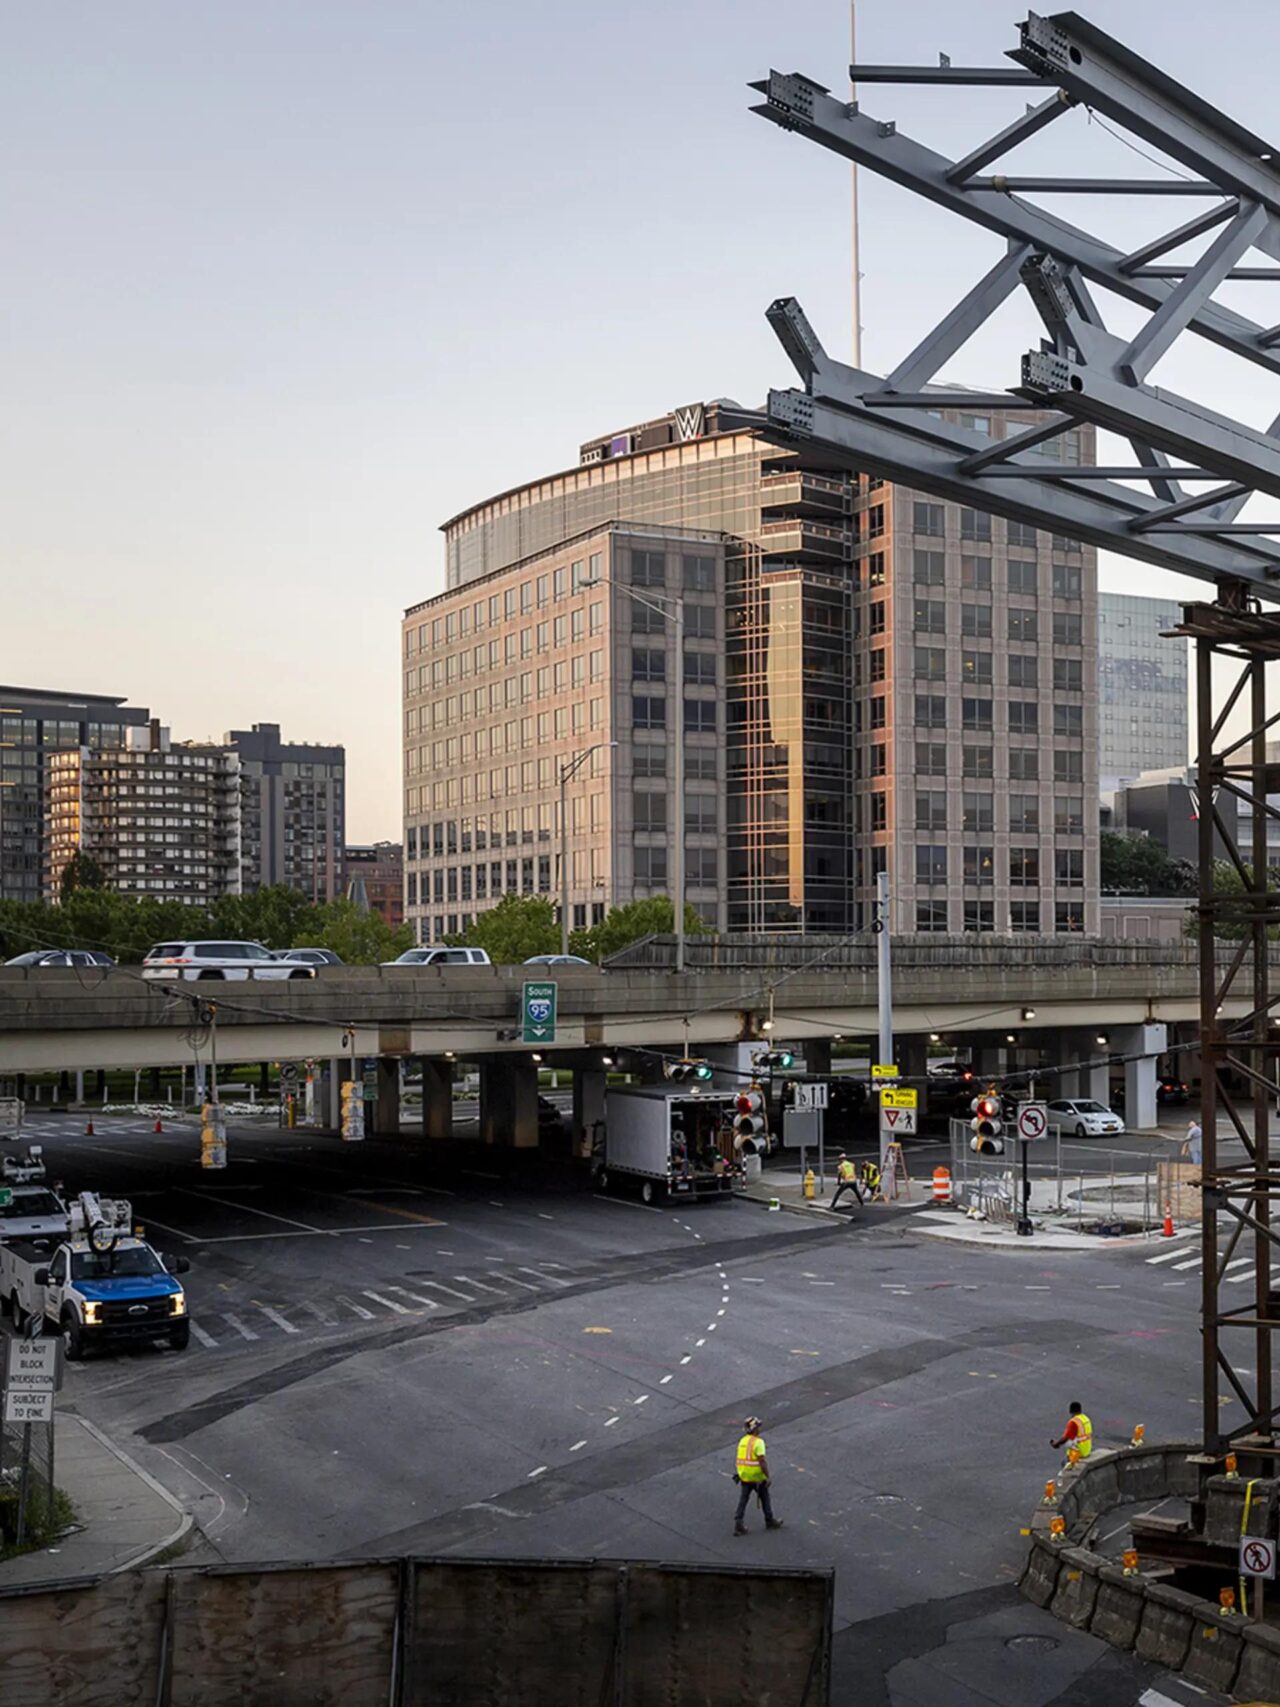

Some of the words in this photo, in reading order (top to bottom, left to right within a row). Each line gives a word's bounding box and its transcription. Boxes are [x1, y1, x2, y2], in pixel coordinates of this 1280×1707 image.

[531, 1005, 548, 1017] 95
[19, 1345, 30, 1354] DO
[32, 1345, 46, 1354] NOT
[20, 1360, 44, 1369] BLOCK
[9, 1375, 54, 1384] INTERSECTION
[13, 1394, 46, 1404] SUBJECT
[14, 1408, 25, 1417] TO
[27, 1408, 43, 1418] FINE
